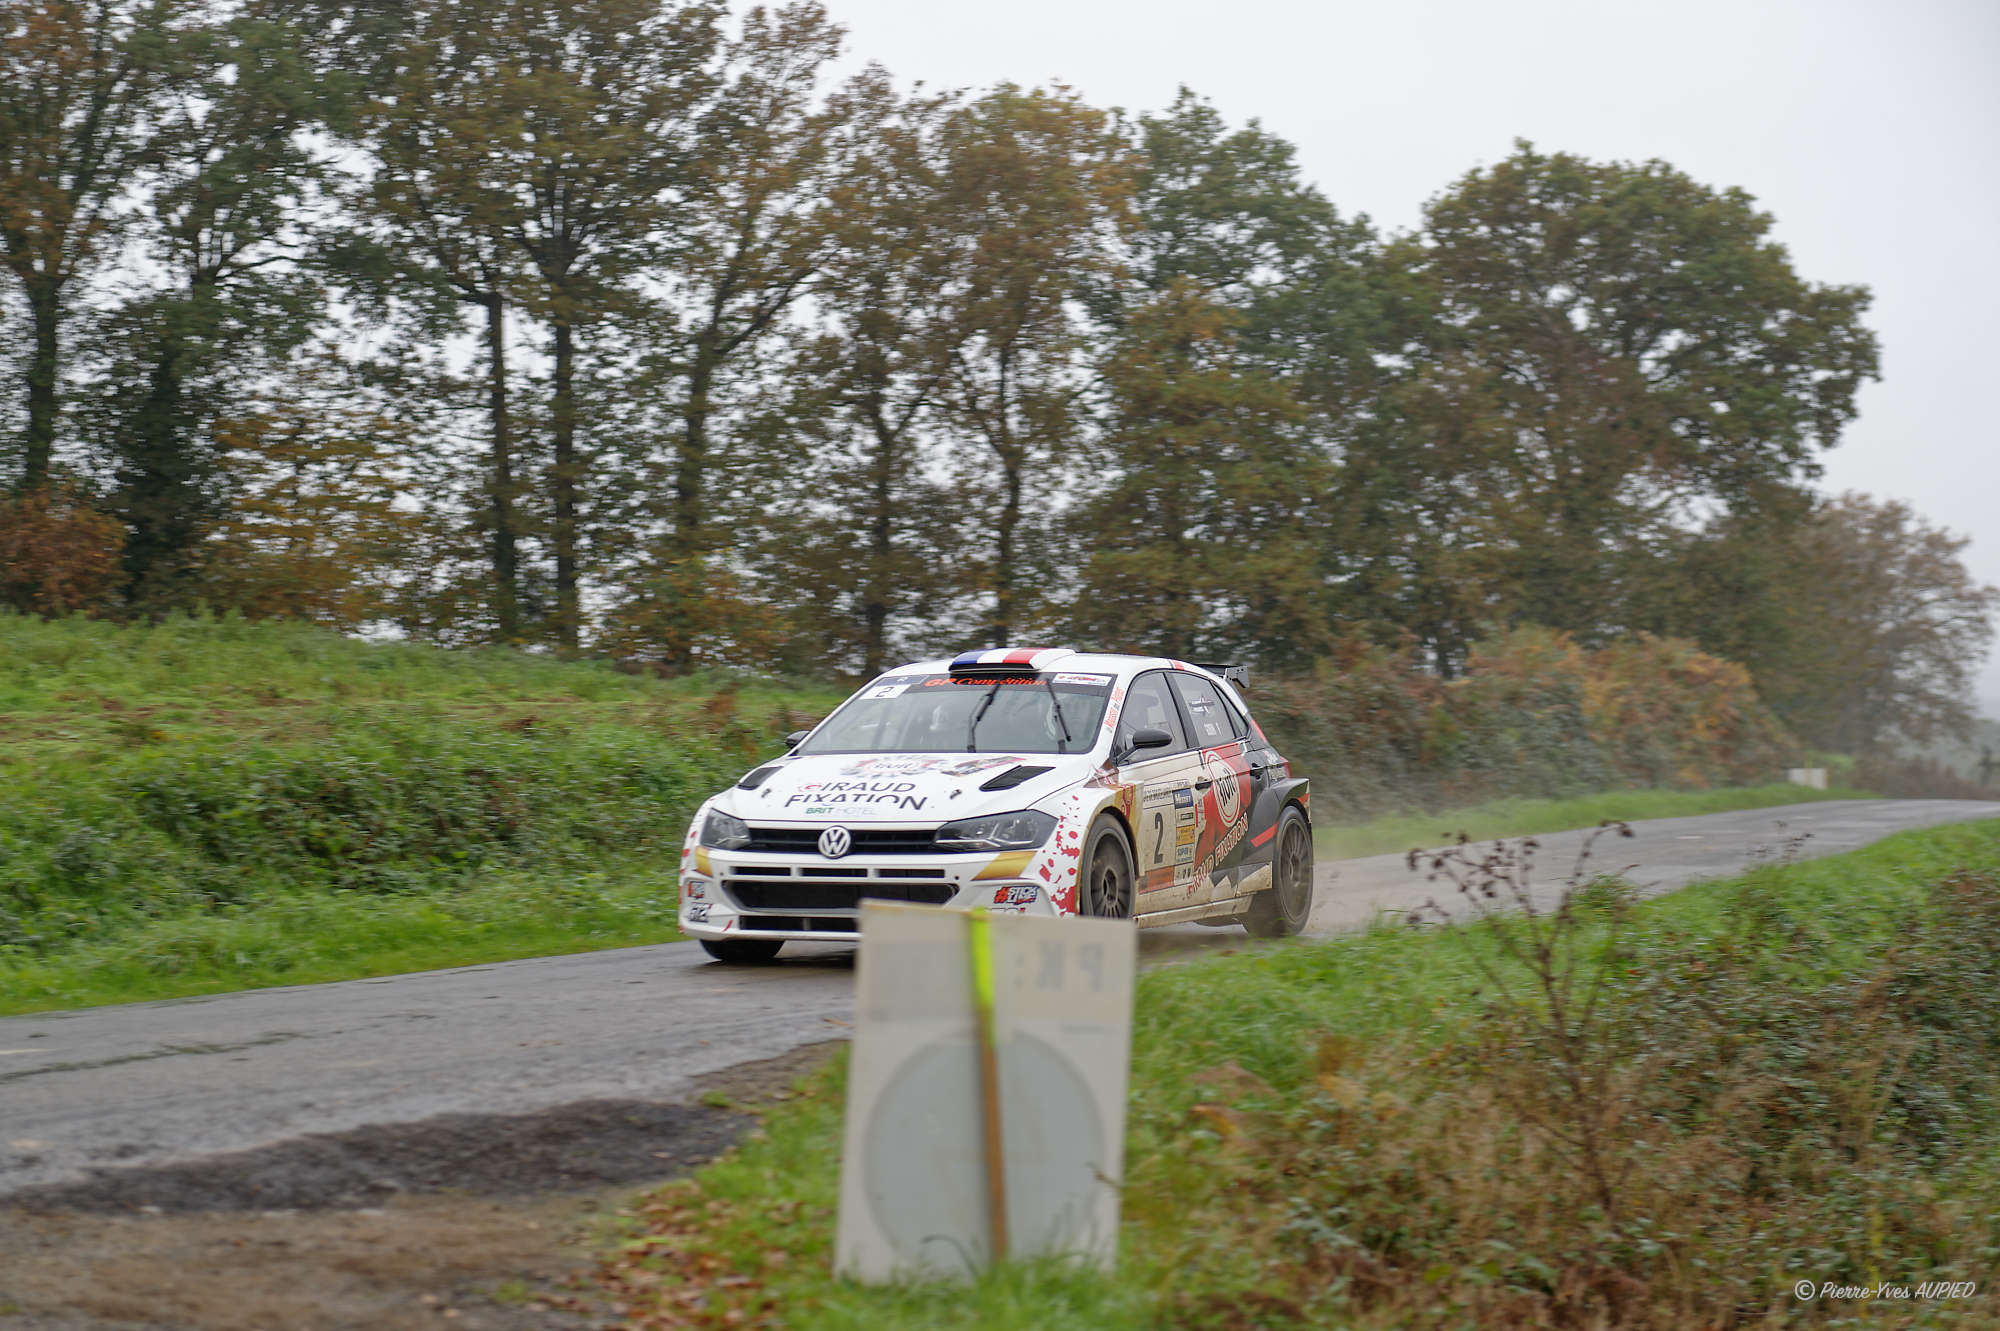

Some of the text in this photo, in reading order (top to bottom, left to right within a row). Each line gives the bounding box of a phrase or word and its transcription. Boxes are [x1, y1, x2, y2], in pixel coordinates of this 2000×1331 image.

[875, 686, 894, 697] 2
[924, 678, 957, 687] GP
[784, 793, 928, 810] FIXATION
[818, 825, 851, 859] VW
[1153, 812, 1164, 864] 2
[1214, 811, 1249, 867] FIXATION
